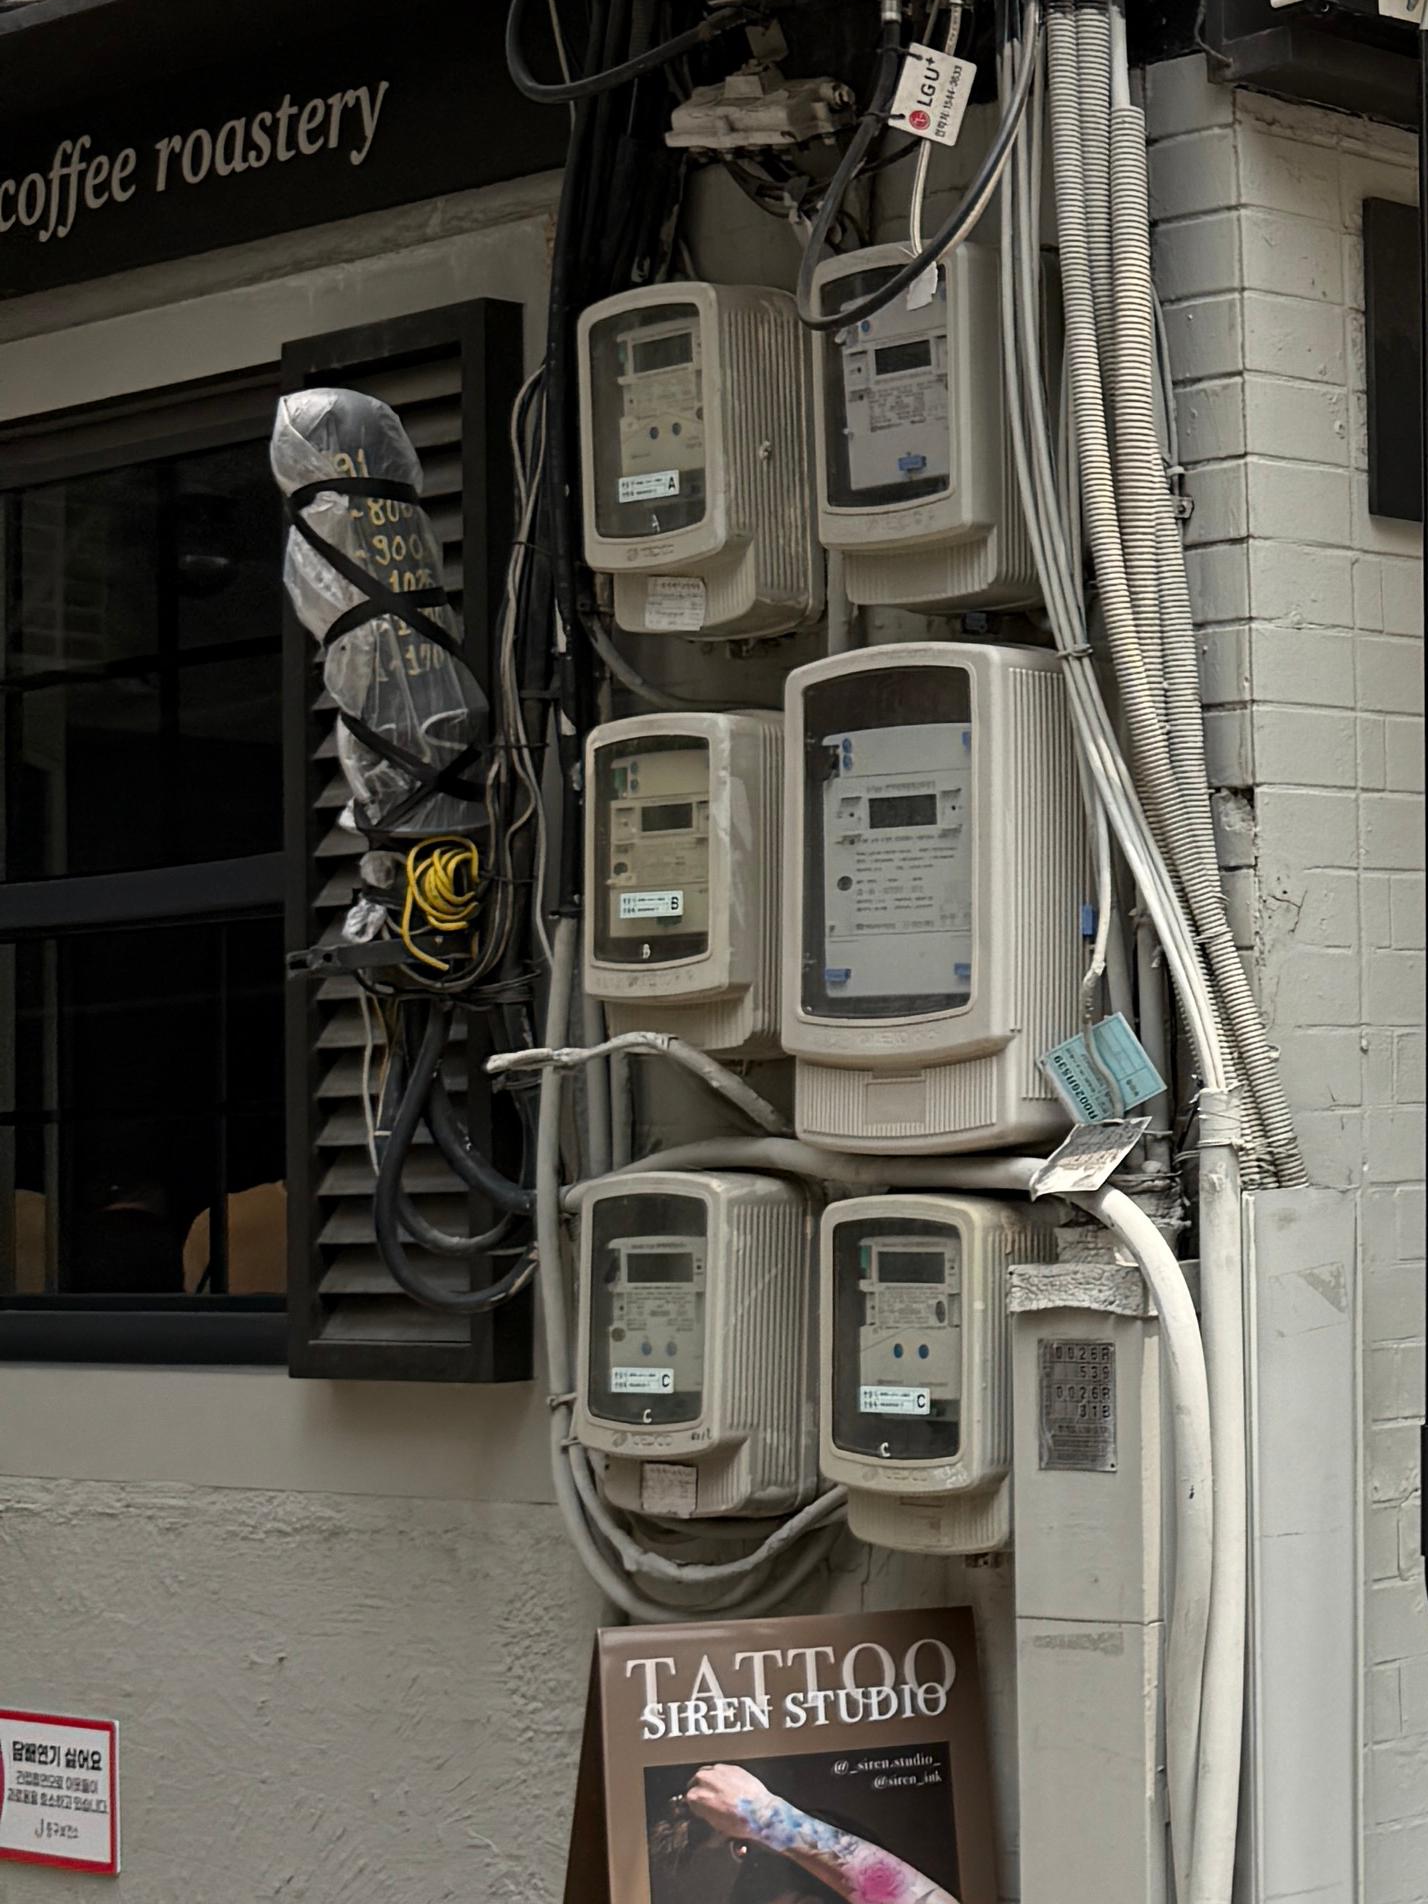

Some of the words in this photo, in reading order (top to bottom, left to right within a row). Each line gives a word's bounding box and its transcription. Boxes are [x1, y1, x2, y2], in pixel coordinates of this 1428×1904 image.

[0, 134, 136, 243] coffee
[154, 80, 391, 193] roastery
[916, 1393, 927, 1410] C
[626, 1636, 957, 1725] TATTOO
[641, 1691, 773, 1743] SIREN
[784, 1681, 948, 1731] STUDIO
